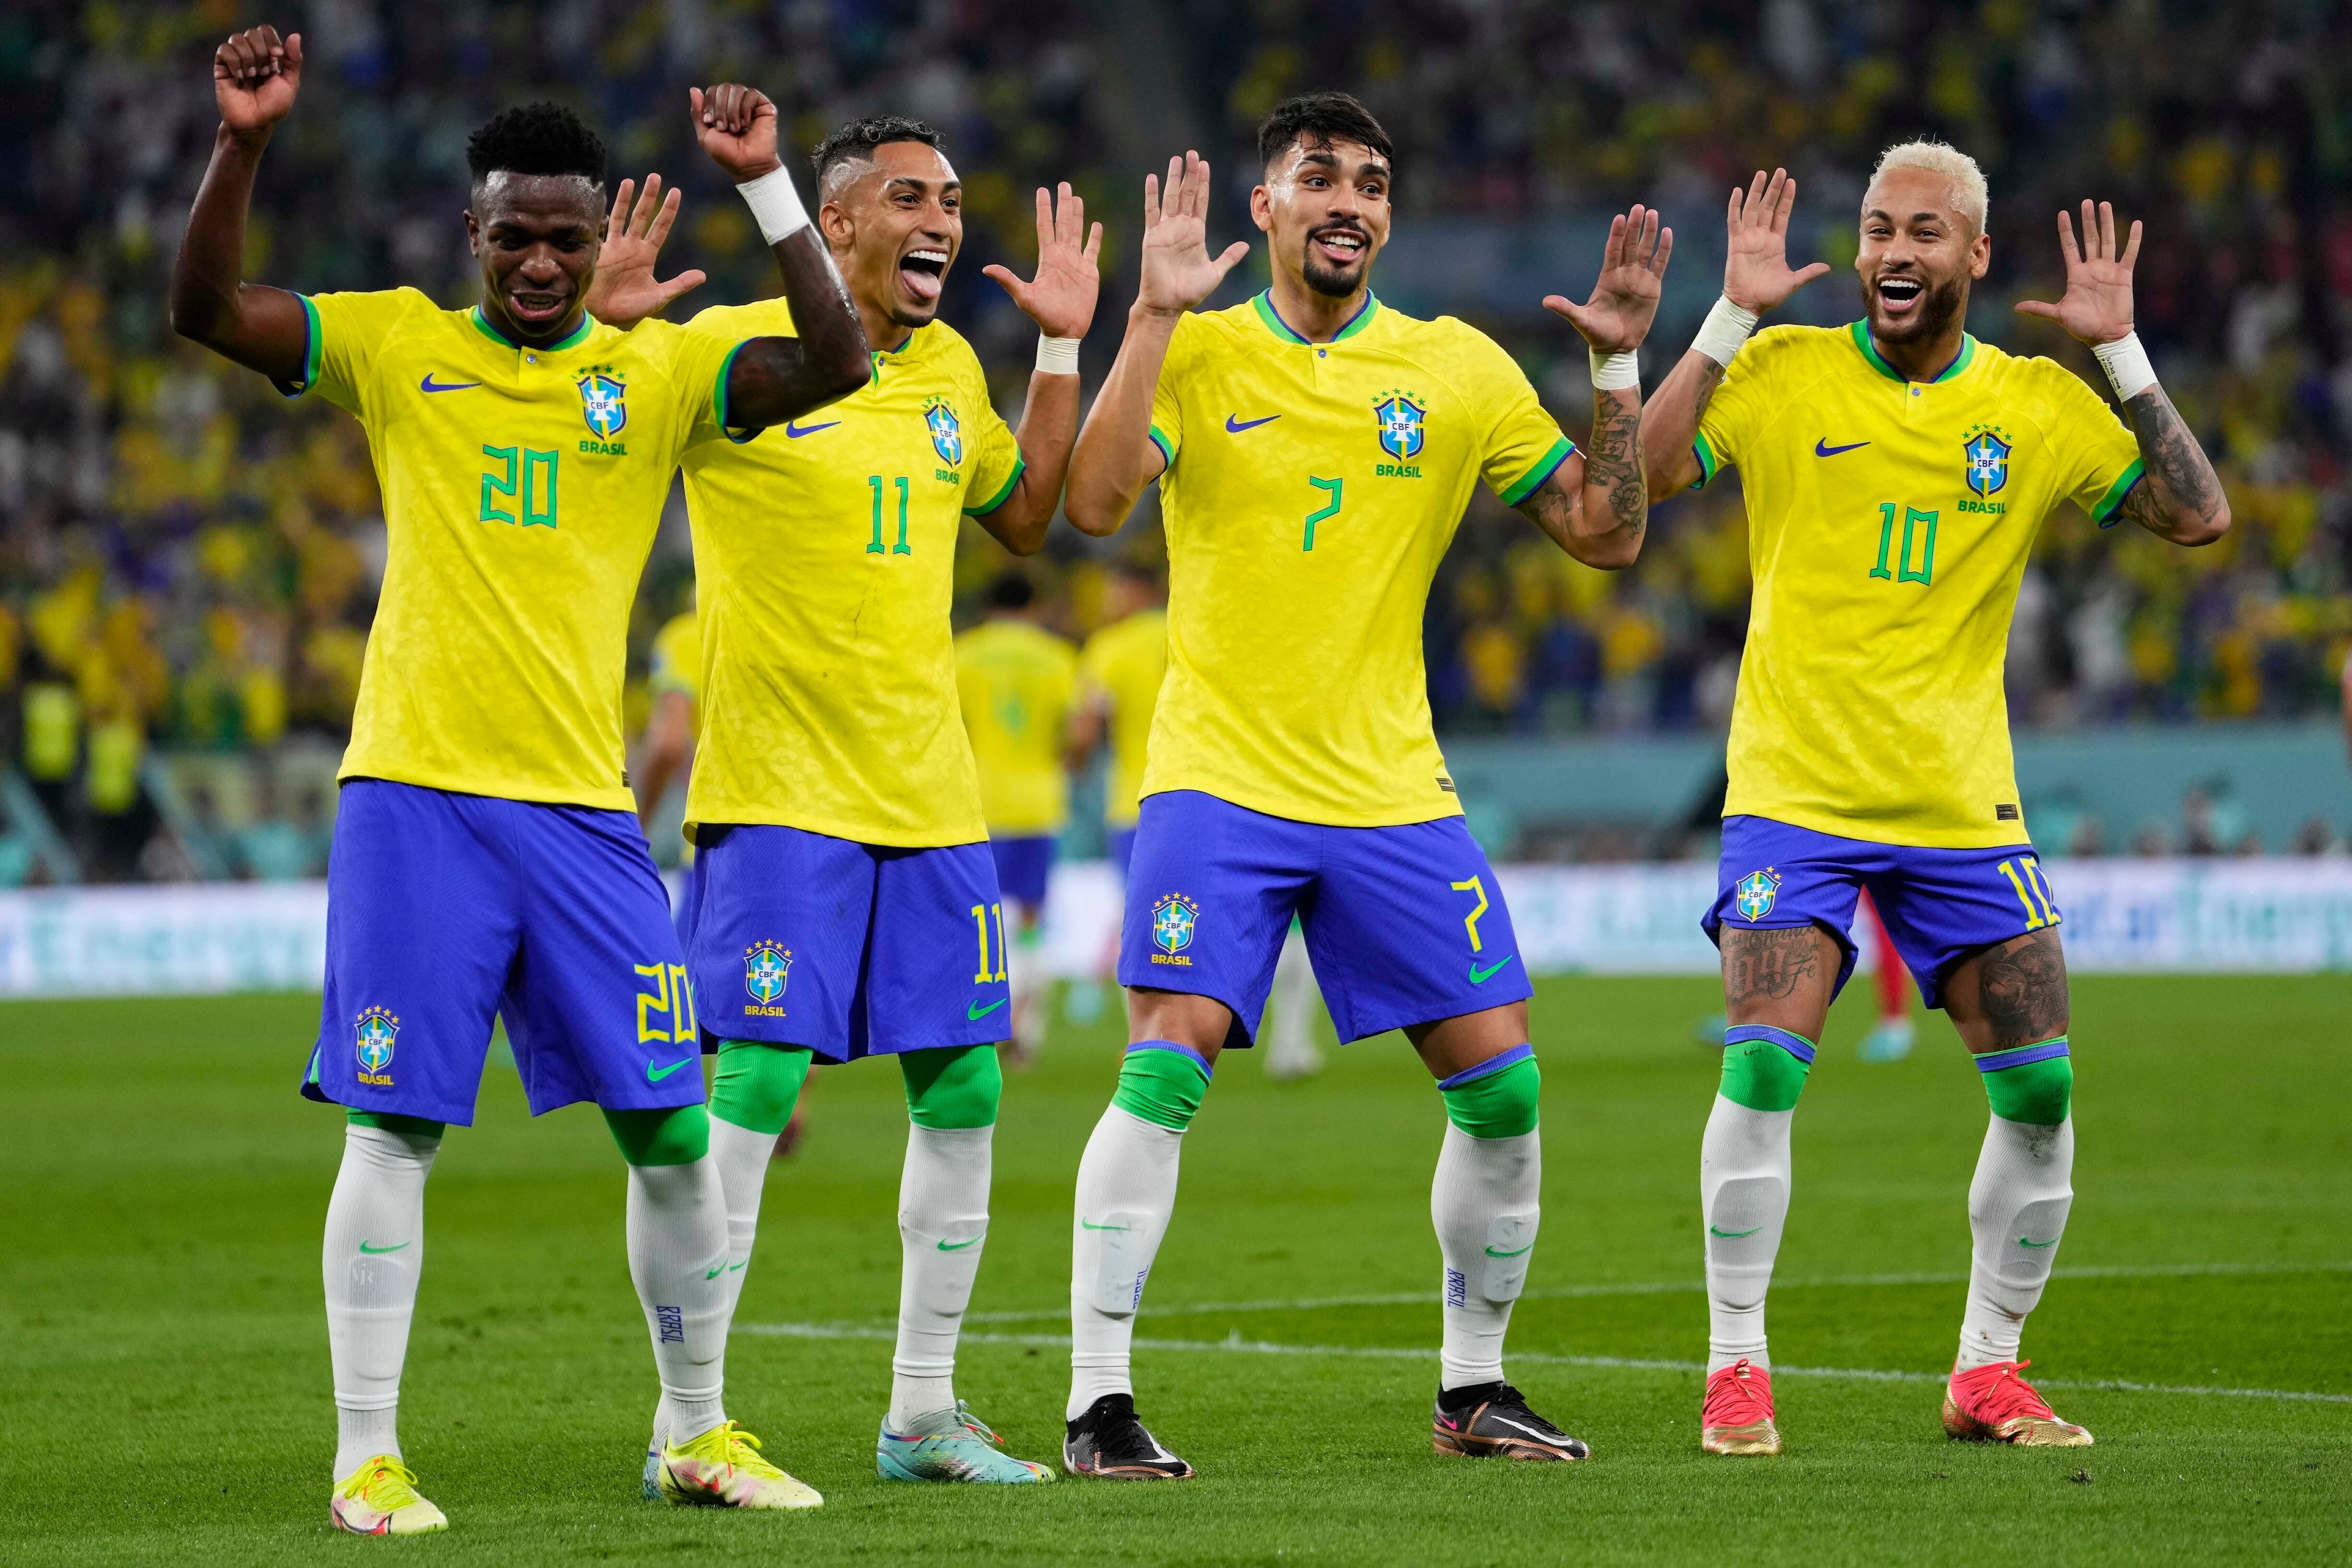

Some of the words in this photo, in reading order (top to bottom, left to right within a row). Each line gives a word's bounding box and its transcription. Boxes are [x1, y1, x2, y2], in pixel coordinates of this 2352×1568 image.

[2107, 357, 2115, 374] DEUS
[939, 429, 953, 438] CBF
[1391, 422, 1411, 432] CBF
[579, 440, 628, 456] BRASIL
[1376, 463, 1422, 478] BRASIL
[1977, 458, 1994, 469] CBF
[479, 444, 559, 529] 20
[1303, 476, 1343, 552] 7
[1957, 499, 2006, 514] BRASIL
[866, 475, 911, 555] 11
[1869, 502, 1939, 586] 10
[1450, 874, 1489, 953] 7
[970, 902, 1008, 985] 11
[1151, 954, 1193, 966] BRASIL
[758, 970, 775, 979] CBF
[634, 960, 696, 1044] 20
[744, 1004, 787, 1018] BRASIL
[358, 1072, 394, 1085] BRASIL
[1447, 1267, 1465, 1308] BRASIL
[656, 1305, 684, 1344] BRASIL
